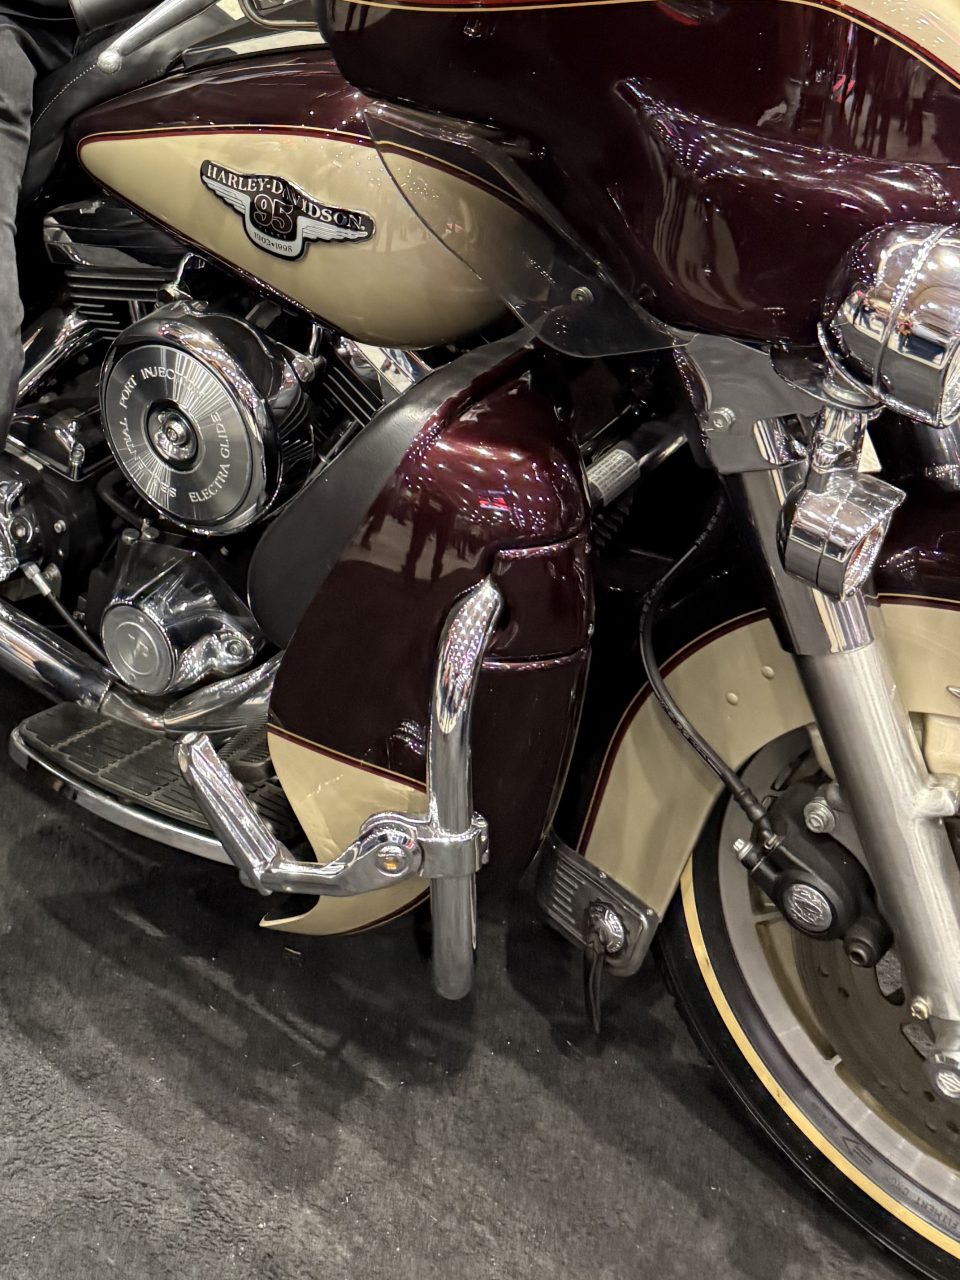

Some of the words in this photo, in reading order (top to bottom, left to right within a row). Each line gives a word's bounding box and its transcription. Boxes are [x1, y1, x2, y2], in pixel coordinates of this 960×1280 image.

[253, 193, 294, 234] 95
[119, 374, 137, 409] PORT
[189, 463, 231, 503] ELECTRA
[211, 411, 231, 459] GLIDE
